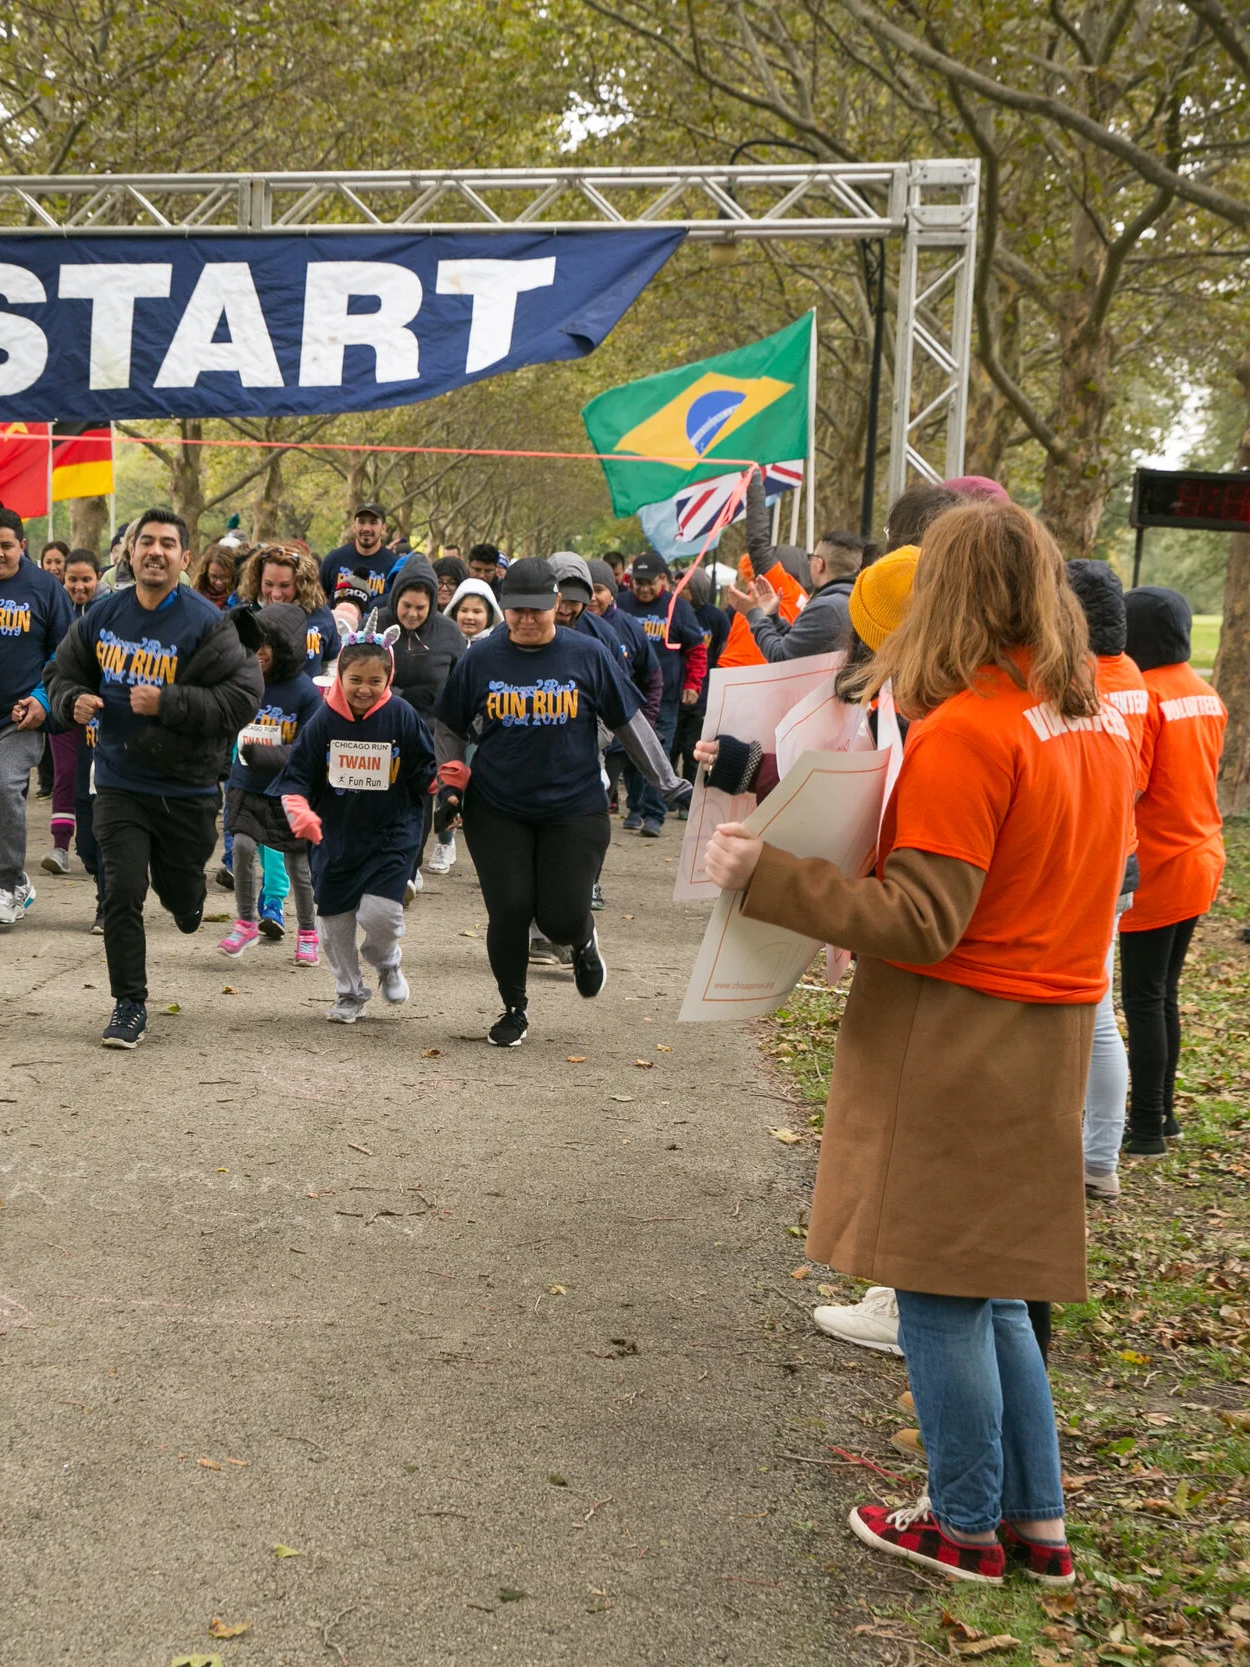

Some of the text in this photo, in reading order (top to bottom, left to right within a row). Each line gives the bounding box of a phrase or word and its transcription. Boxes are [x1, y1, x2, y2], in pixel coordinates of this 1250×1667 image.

[96, 640, 178, 685] FUN RUN
[541, 679, 576, 697] Run
[487, 689, 579, 720] FUN RUN
[1159, 695, 1223, 722] VOLUNTEER
[532, 712, 568, 726] 2019
[335, 742, 370, 750] CHICAGO
[338, 755, 381, 770] TWAIN
[348, 777, 382, 787] Fun Run
